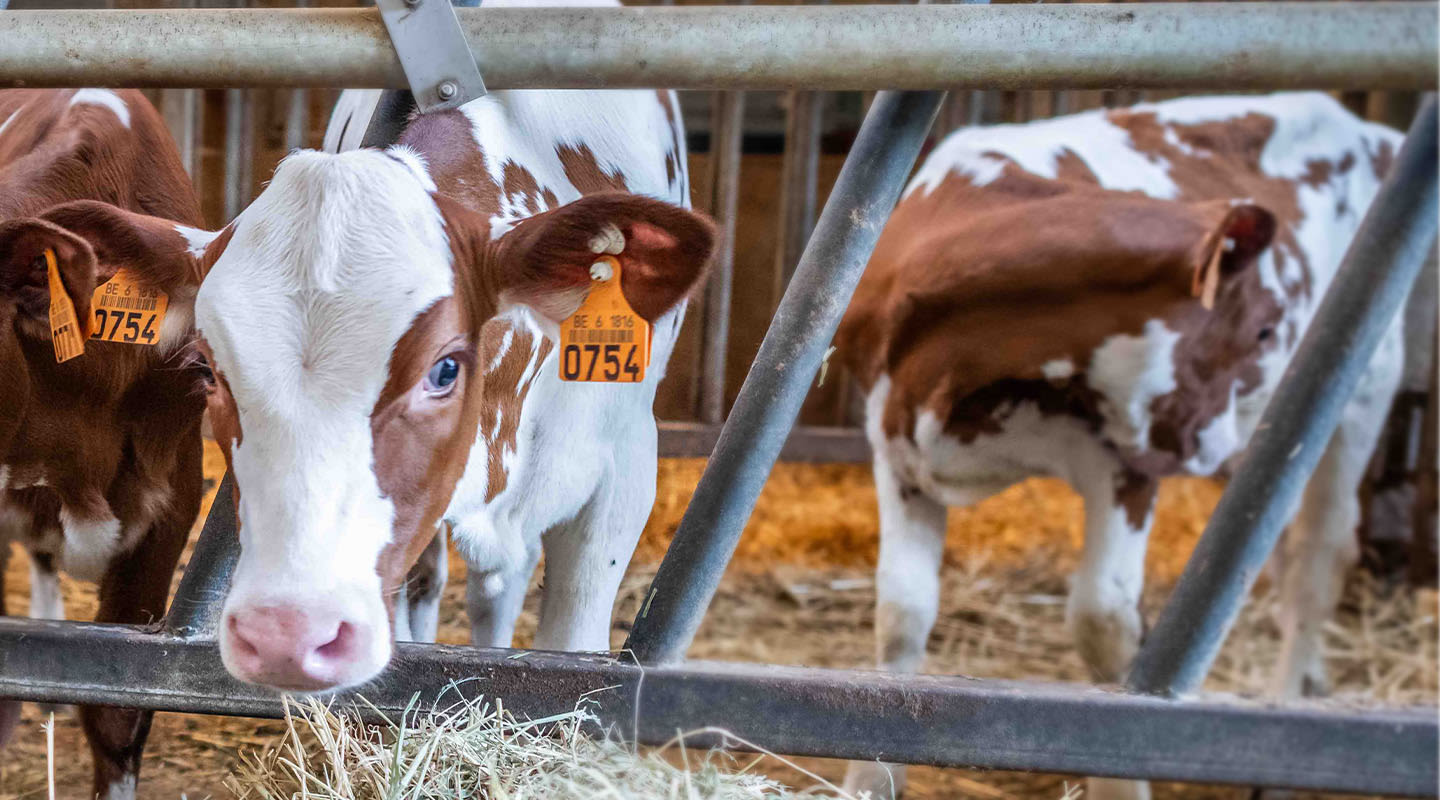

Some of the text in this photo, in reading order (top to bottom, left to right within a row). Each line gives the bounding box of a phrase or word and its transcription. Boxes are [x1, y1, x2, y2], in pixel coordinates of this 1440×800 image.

[106, 282, 120, 295] BE
[125, 285, 132, 296] 6
[573, 315, 588, 328] BE
[595, 315, 602, 328] 6
[564, 345, 640, 381] 0754
